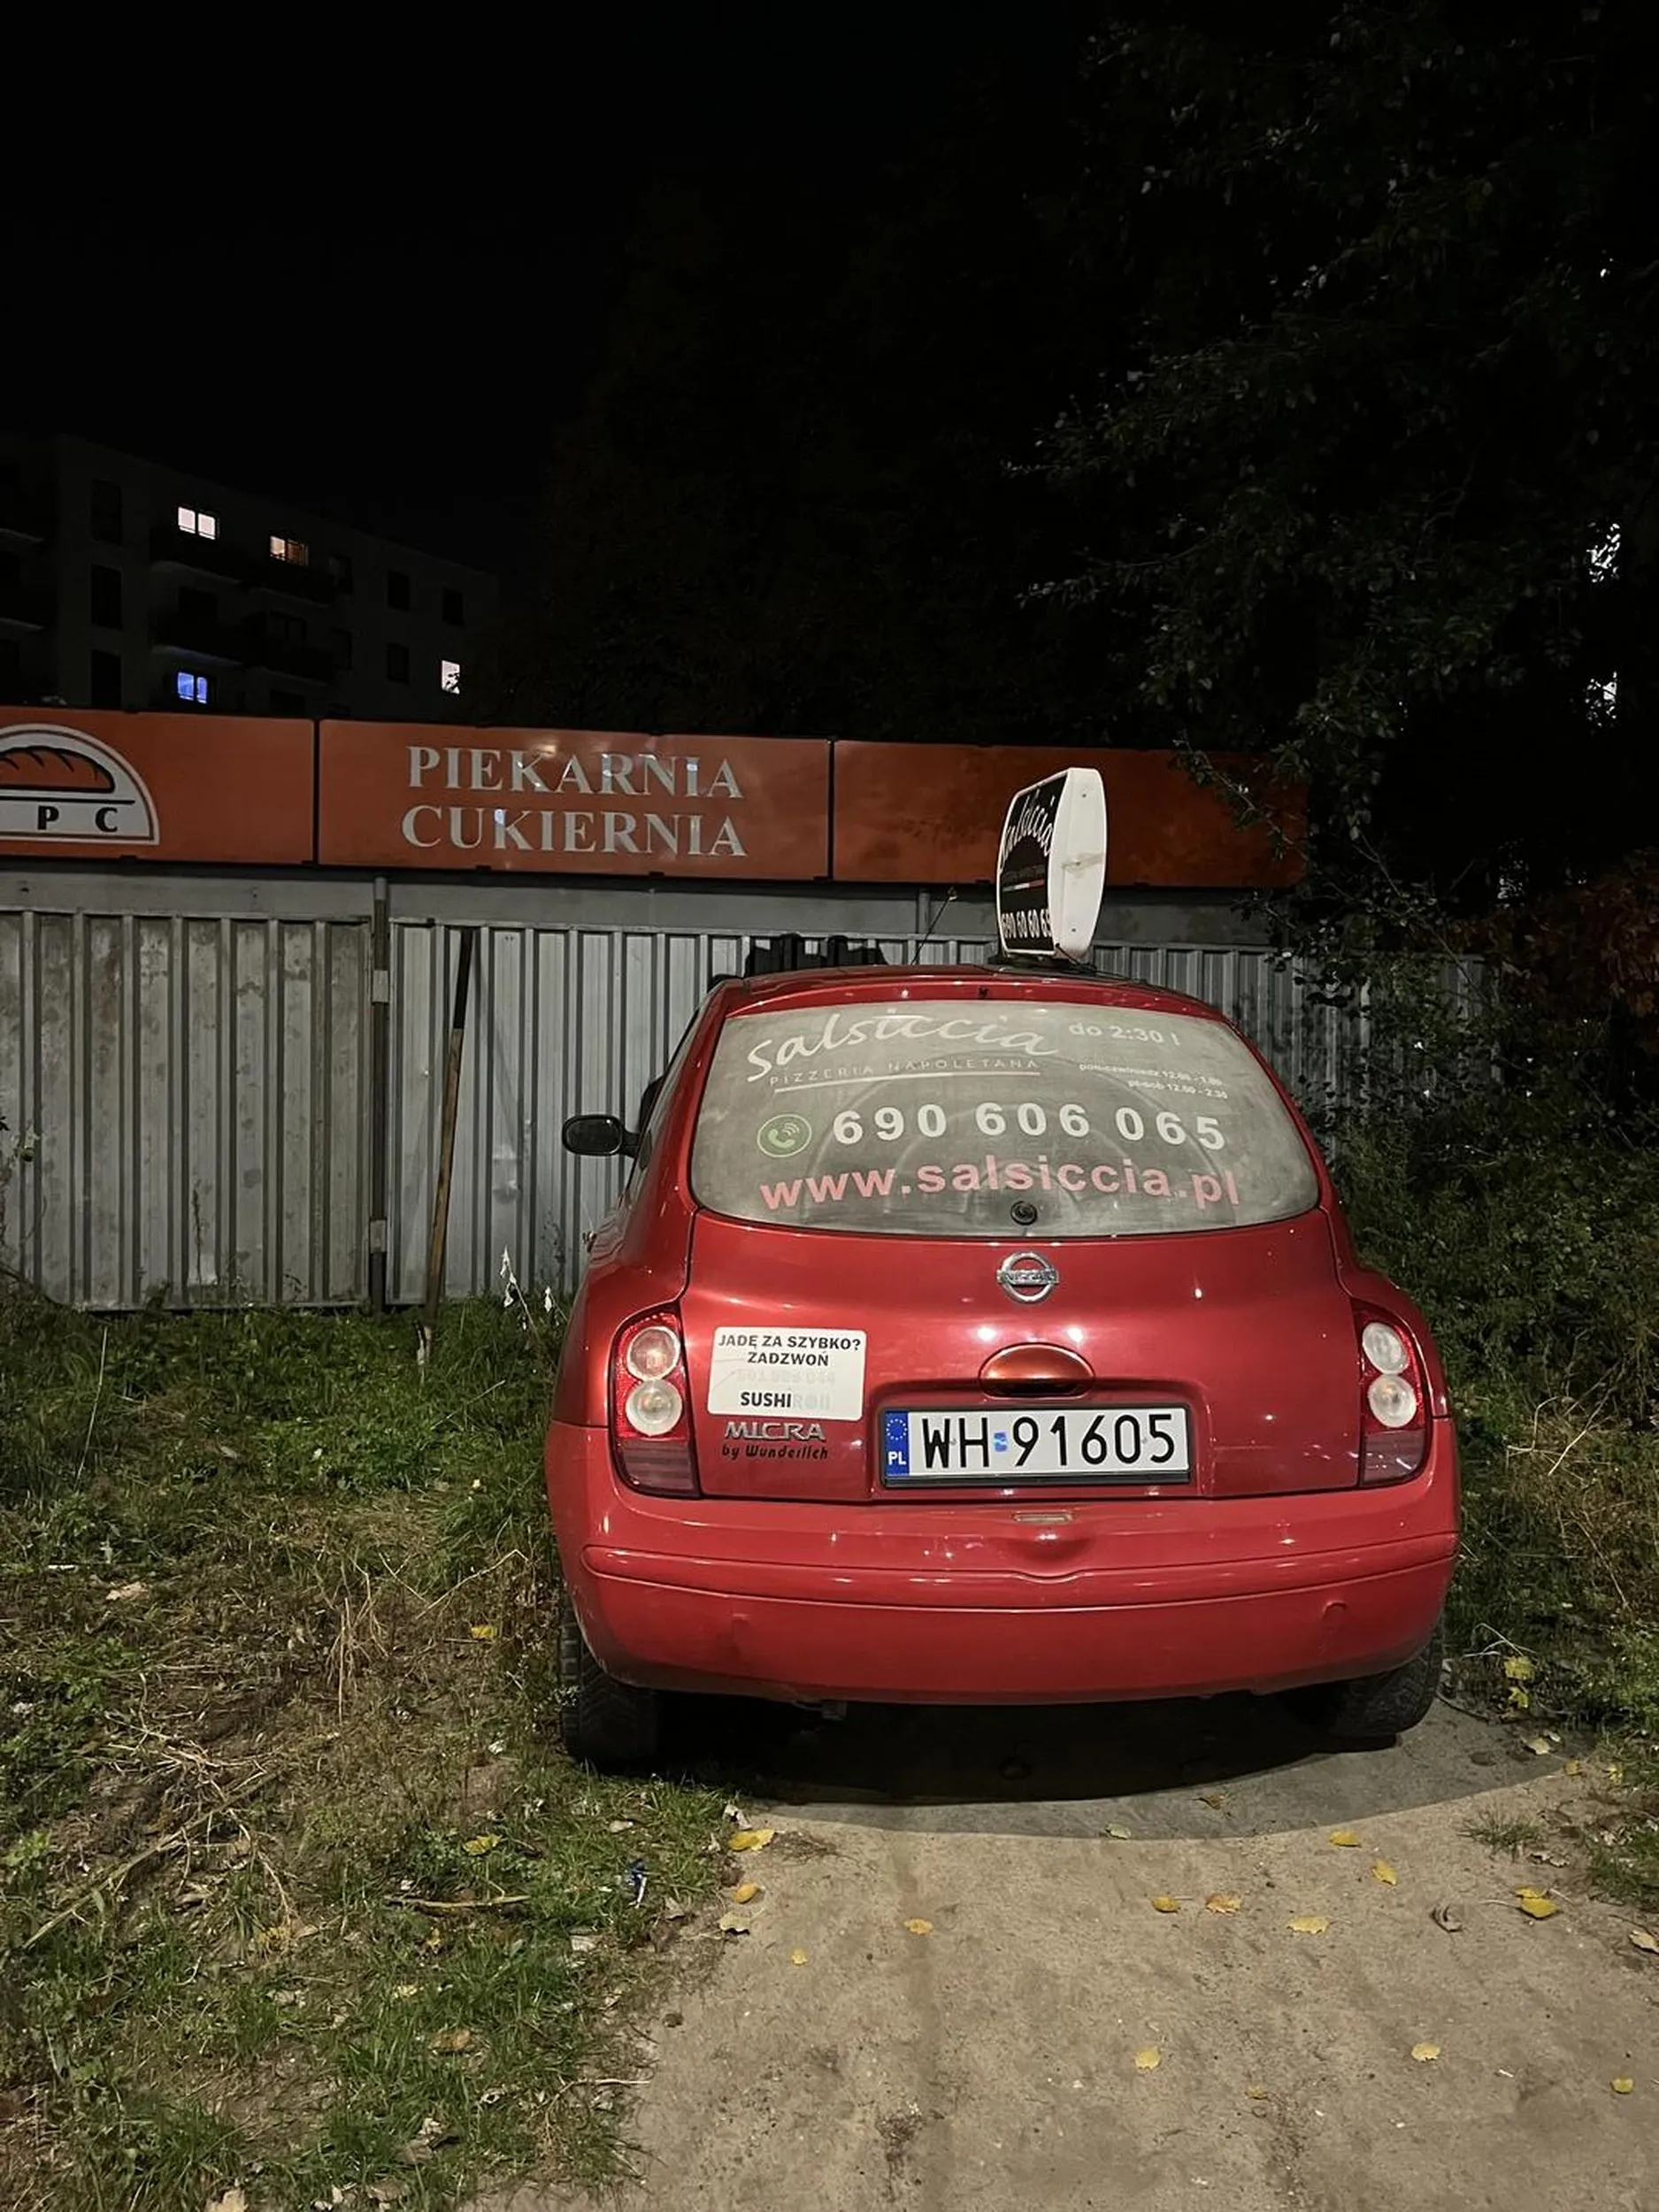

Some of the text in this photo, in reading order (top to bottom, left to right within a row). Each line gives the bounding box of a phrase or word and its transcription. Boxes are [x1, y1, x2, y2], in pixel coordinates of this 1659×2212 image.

[406, 746, 743, 798] PIEKARNIA
[401, 804, 747, 856] CUKIERNIA
[1068, 1022, 1103, 1038] do
[1109, 1024, 1165, 1044] 2:30
[770, 1058, 1040, 1086] PIZZERIA NAPOLETANA
[833, 1102, 1226, 1151] 690 606 065
[759, 1154, 1240, 1211] www.salsiccia.pl
[718, 1334, 861, 1351] JADĘ ZA SZYBKO?
[747, 1350, 829, 1367] ZADZWOŃ
[724, 1420, 826, 1443] MICRA
[921, 1413, 1175, 1469] WH 91605
[721, 1444, 828, 1460] by Wunderlich
[887, 1450, 907, 1465] PL
